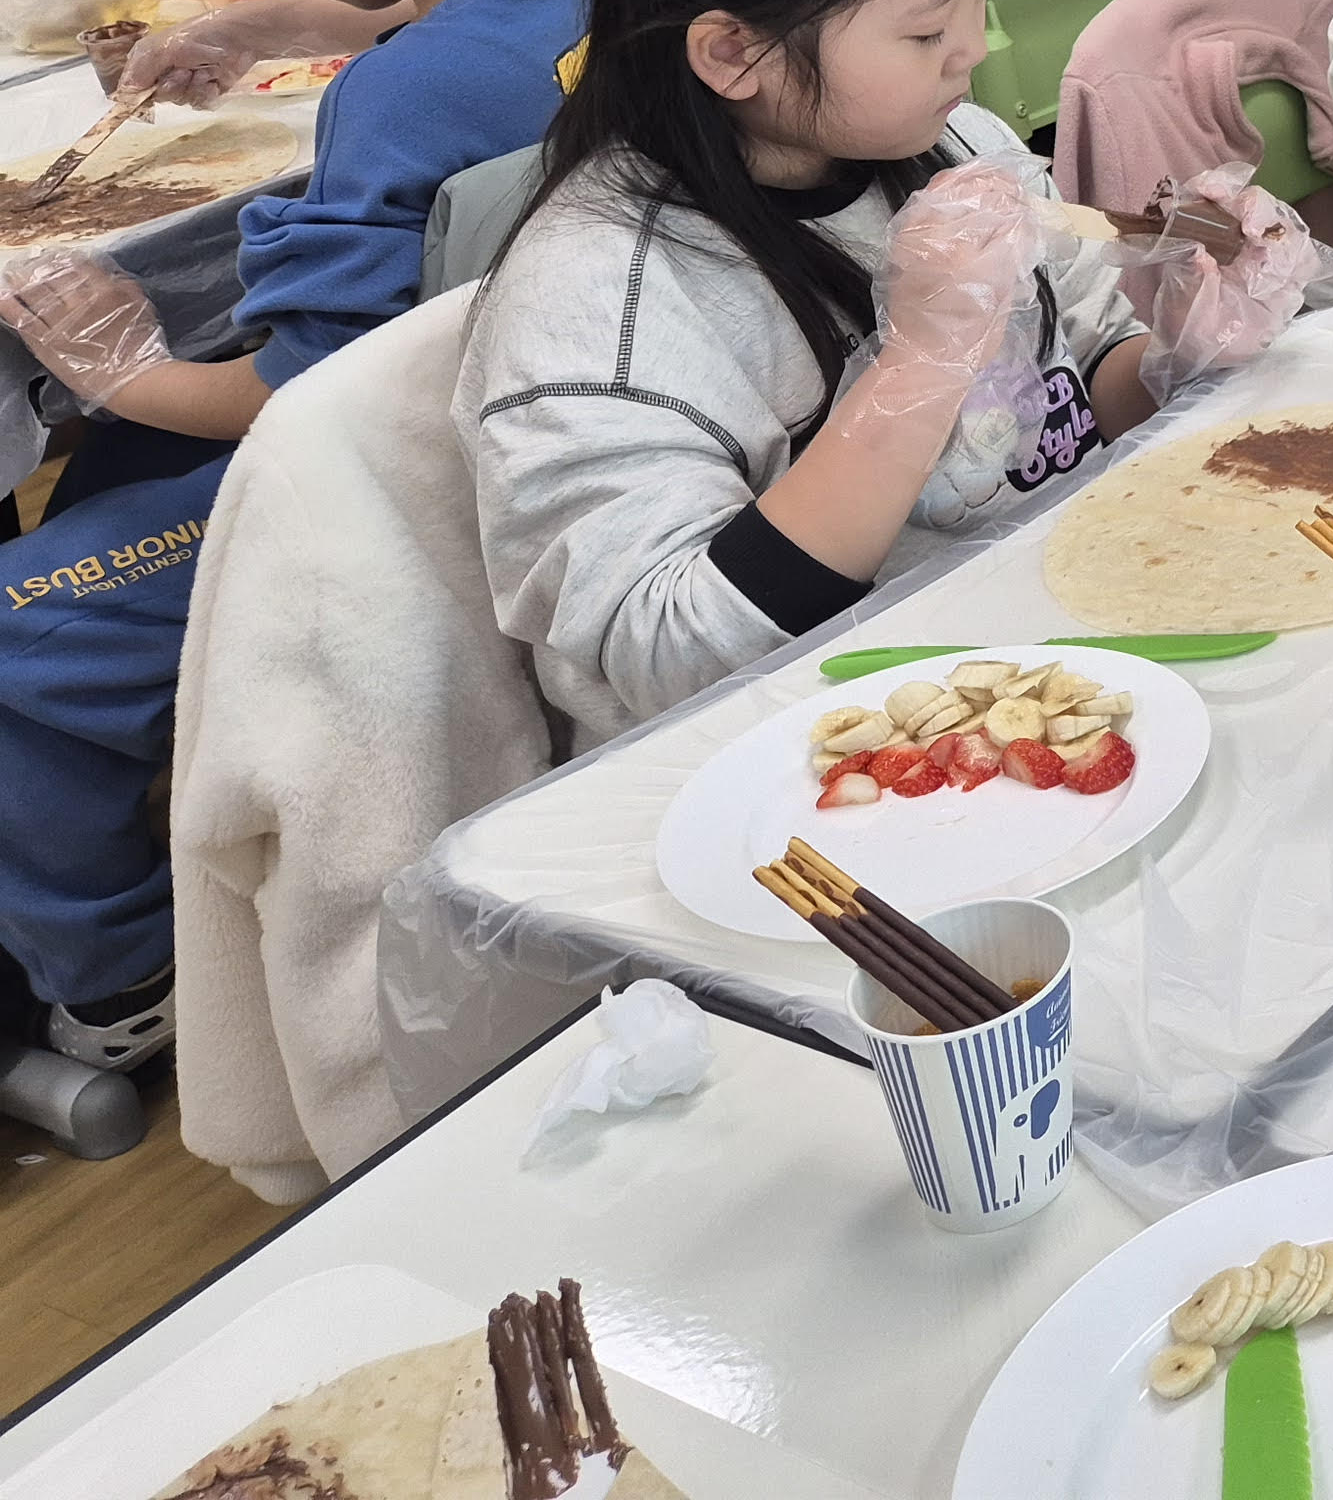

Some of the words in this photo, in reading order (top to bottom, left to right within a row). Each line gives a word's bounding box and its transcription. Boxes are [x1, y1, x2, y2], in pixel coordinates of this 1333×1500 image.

[108, 520, 209, 569] INOR
[125, 548, 193, 583] GENTLE
[5, 556, 105, 610] BUST
[72, 576, 126, 599] LIGHT
